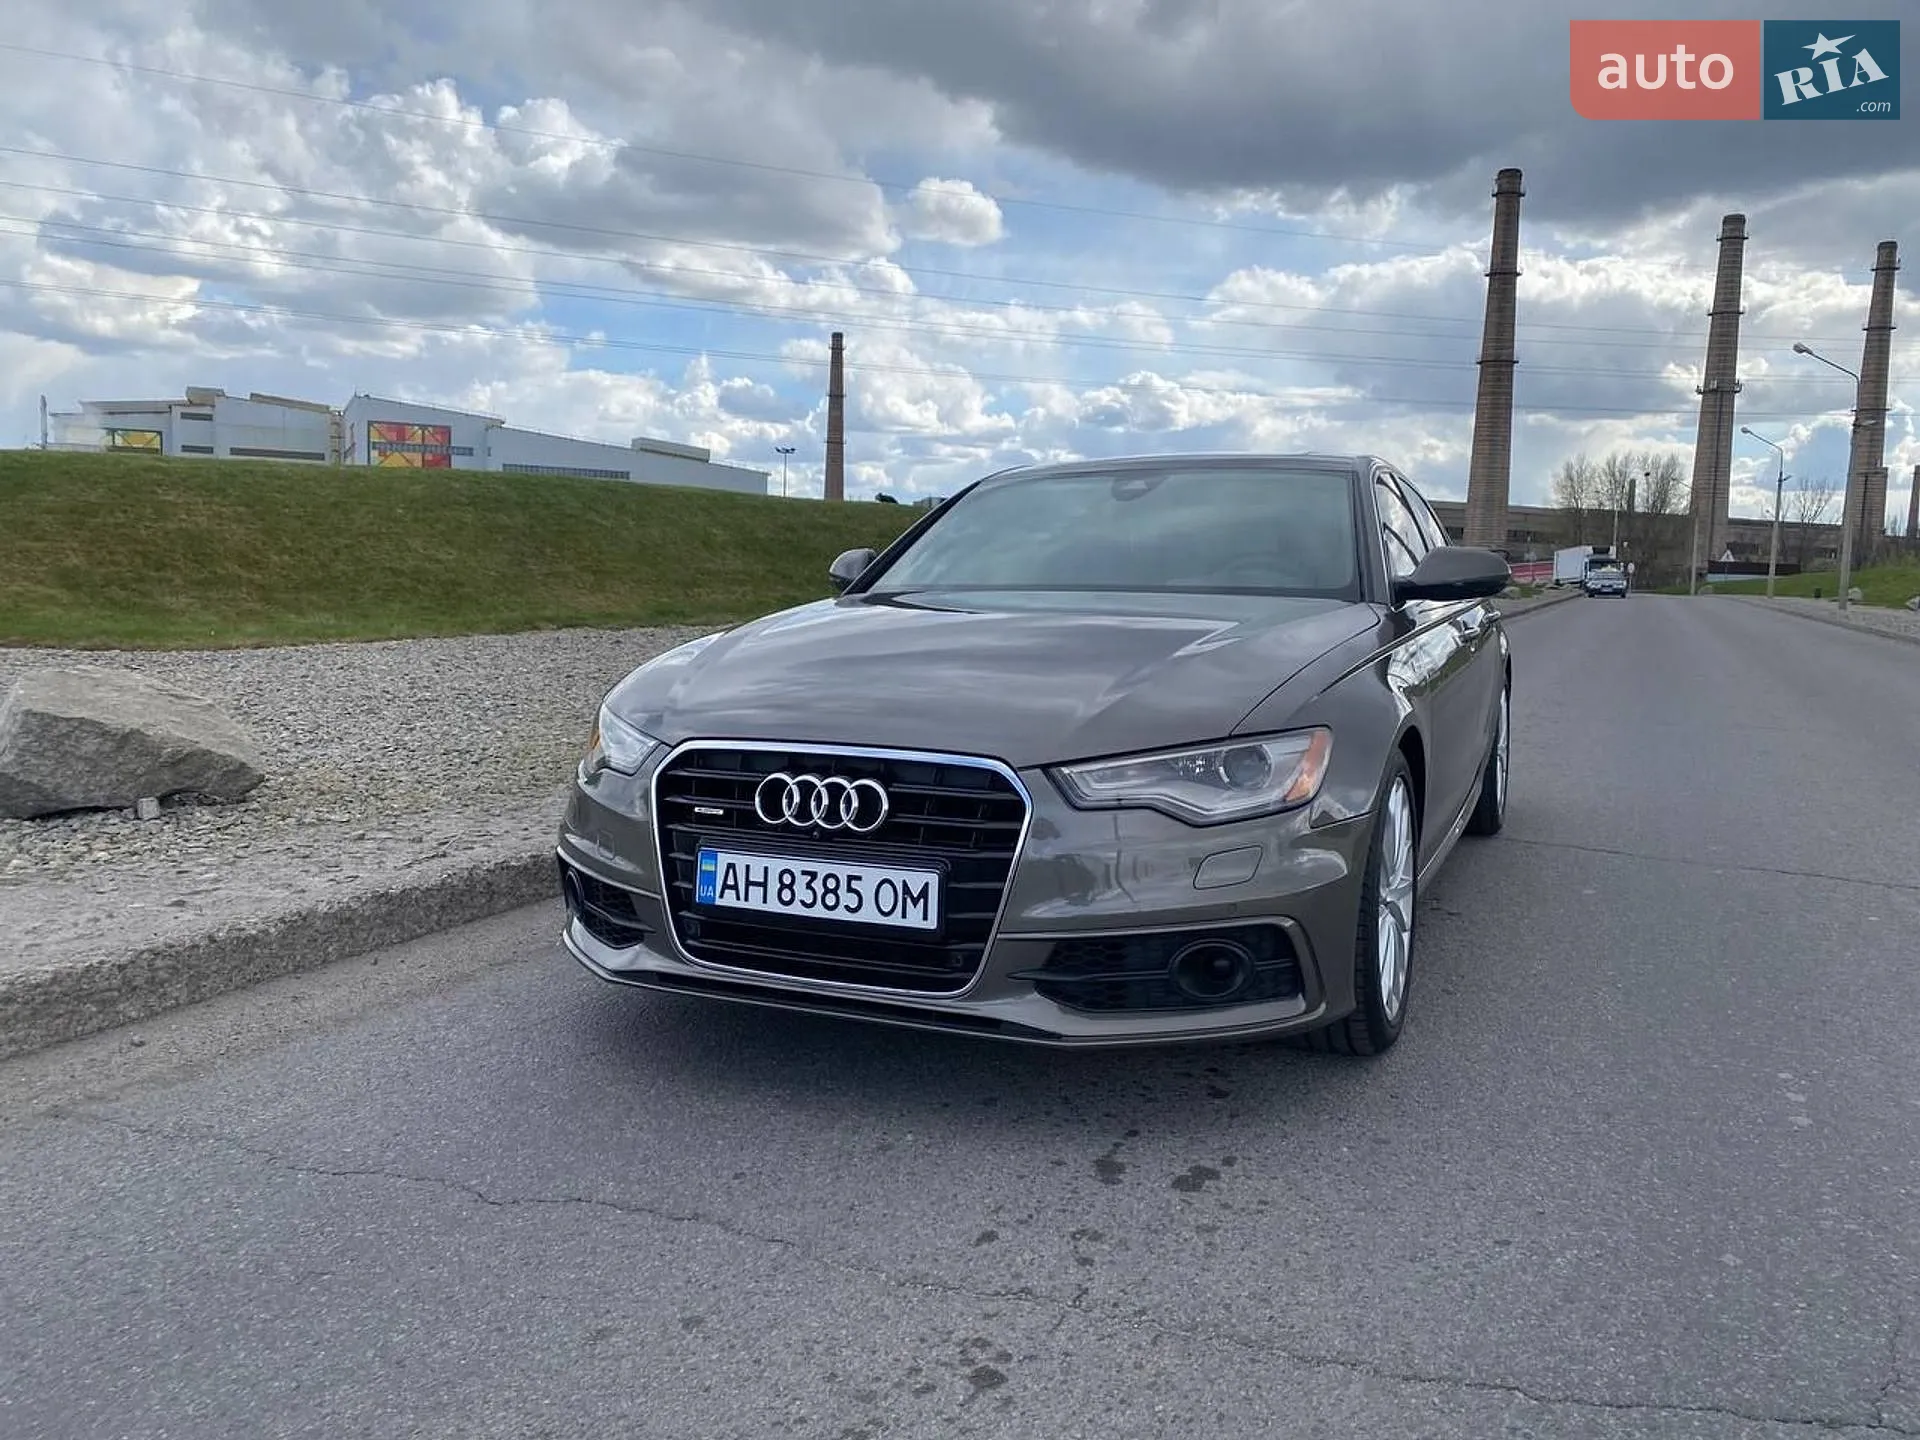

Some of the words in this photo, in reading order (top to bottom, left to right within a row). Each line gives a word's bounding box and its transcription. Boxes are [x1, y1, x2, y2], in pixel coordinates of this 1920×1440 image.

[700, 884, 714, 897] UA
[718, 862, 769, 905] AH
[776, 868, 864, 914] 8385
[874, 877, 930, 922] OM
